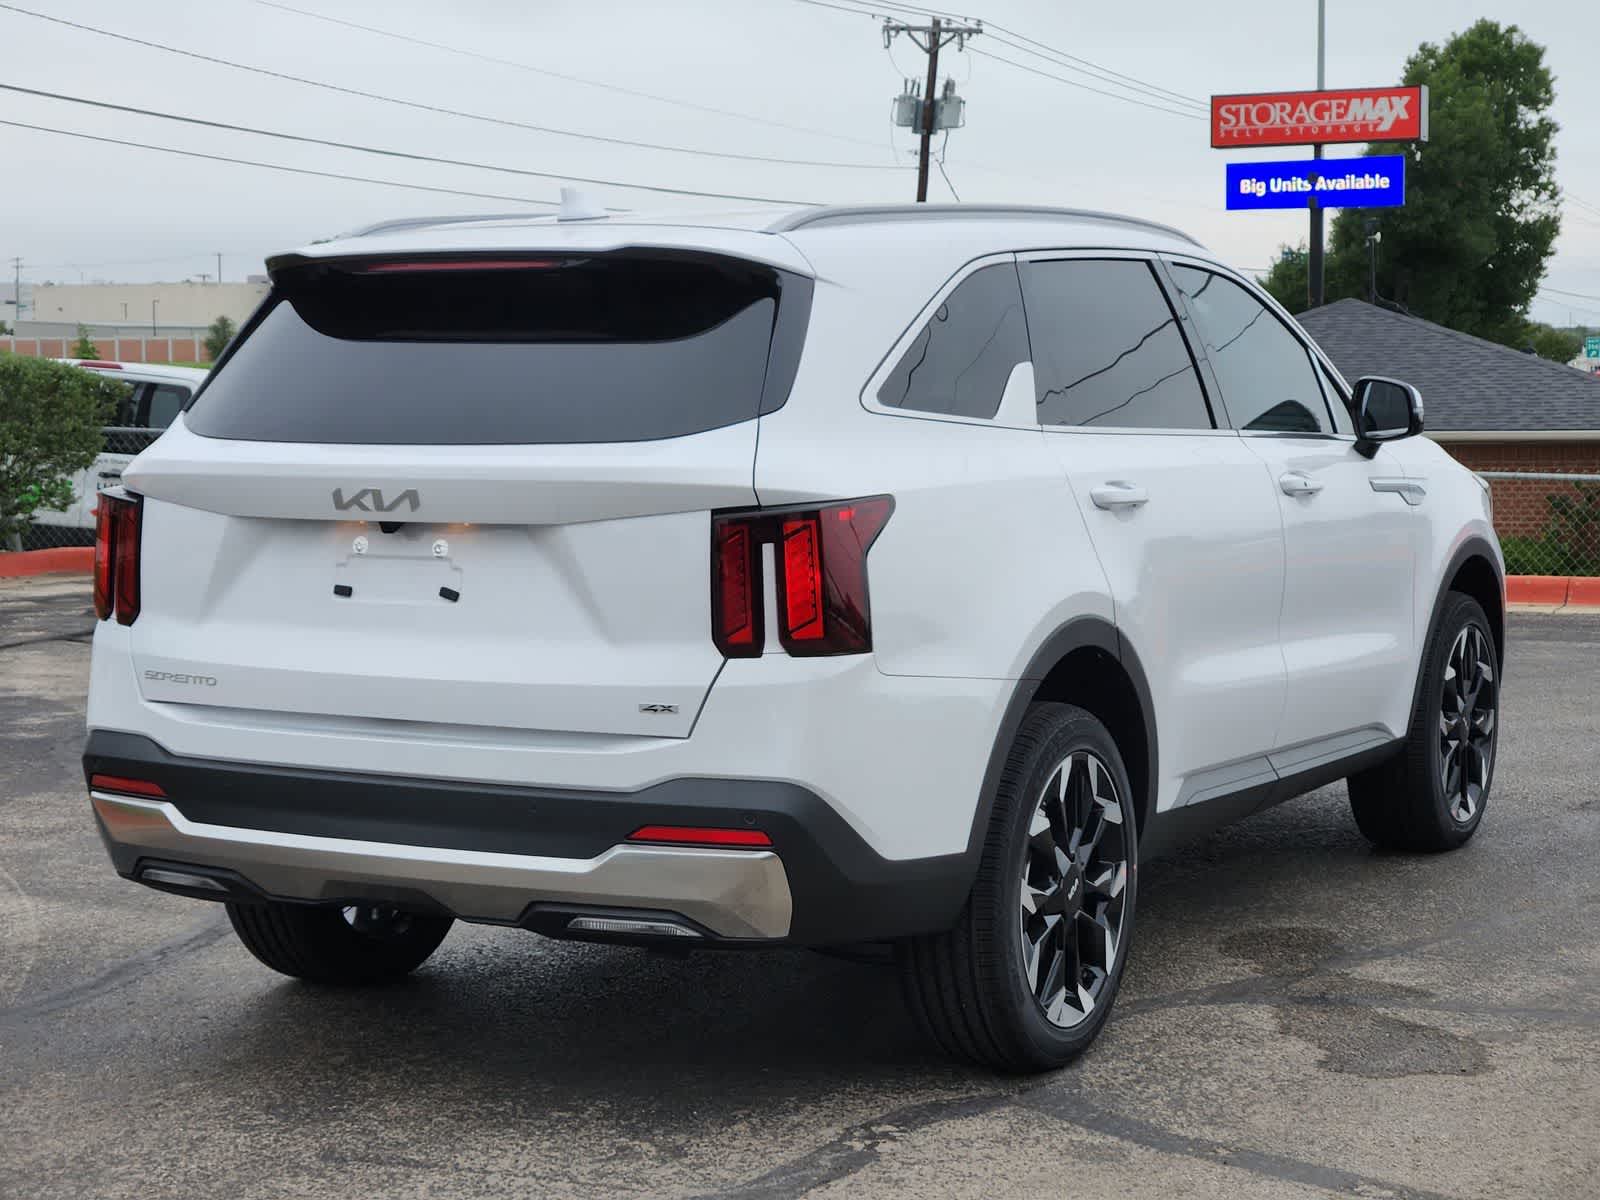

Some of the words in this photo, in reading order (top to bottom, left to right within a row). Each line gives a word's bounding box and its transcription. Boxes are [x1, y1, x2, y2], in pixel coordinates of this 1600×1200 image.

[1219, 96, 1411, 131] STORAGEMAX
[1219, 126, 1264, 138] SELF
[1284, 123, 1375, 136] STORAGE
[1240, 178, 1266, 197] Big
[1270, 176, 1312, 193] Units
[1314, 173, 1390, 191] Available
[332, 488, 421, 512] KIA
